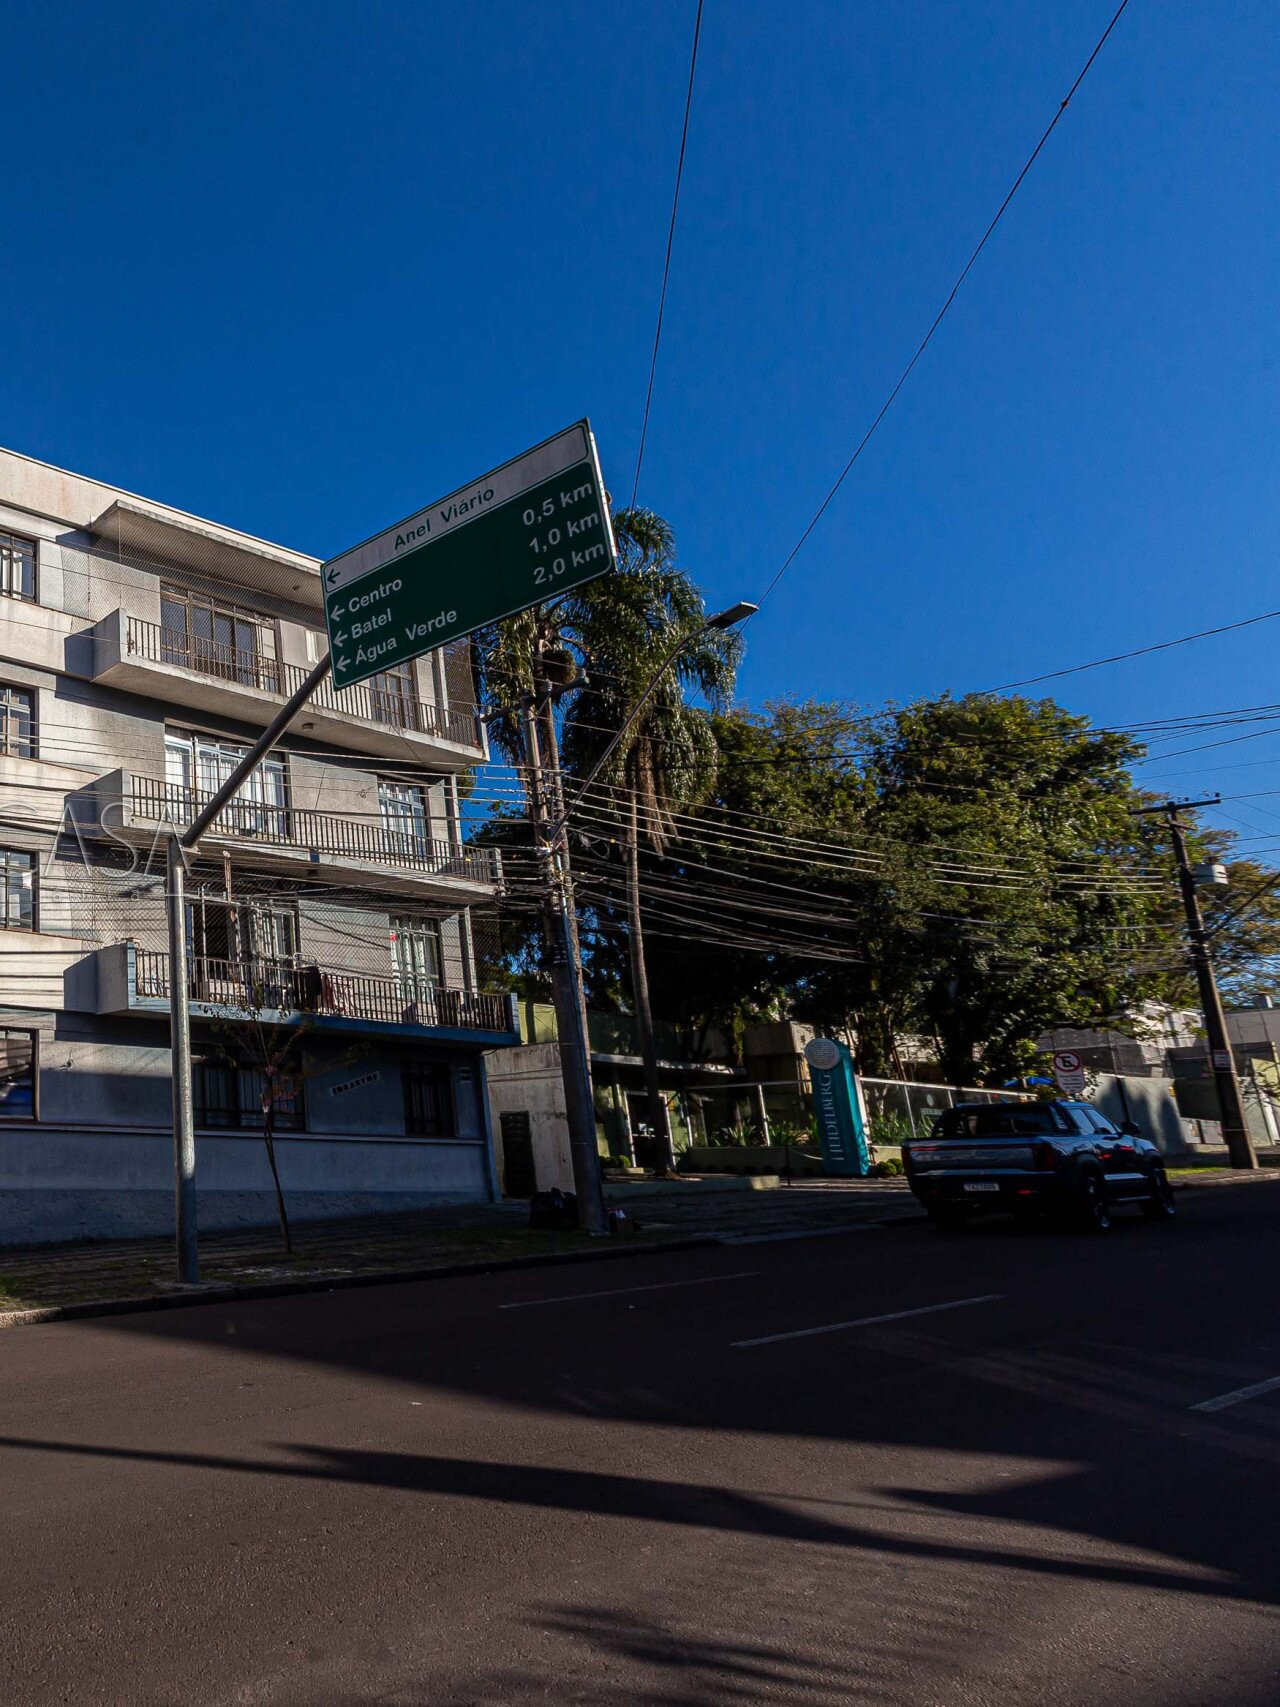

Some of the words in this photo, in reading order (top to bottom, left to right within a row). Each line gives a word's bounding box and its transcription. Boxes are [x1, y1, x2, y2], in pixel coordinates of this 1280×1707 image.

[394, 519, 431, 550] Anel
[440, 487, 494, 524] Viário
[523, 498, 555, 527] 0,5
[560, 482, 593, 506] km
[529, 527, 561, 556] 1,0
[567, 511, 600, 537] km
[533, 557, 566, 585] 2,0
[571, 542, 605, 570] km
[349, 577, 403, 613] Centro
[351, 609, 392, 640] Batel
[355, 637, 397, 667] Água
[405, 609, 458, 641] Verde
